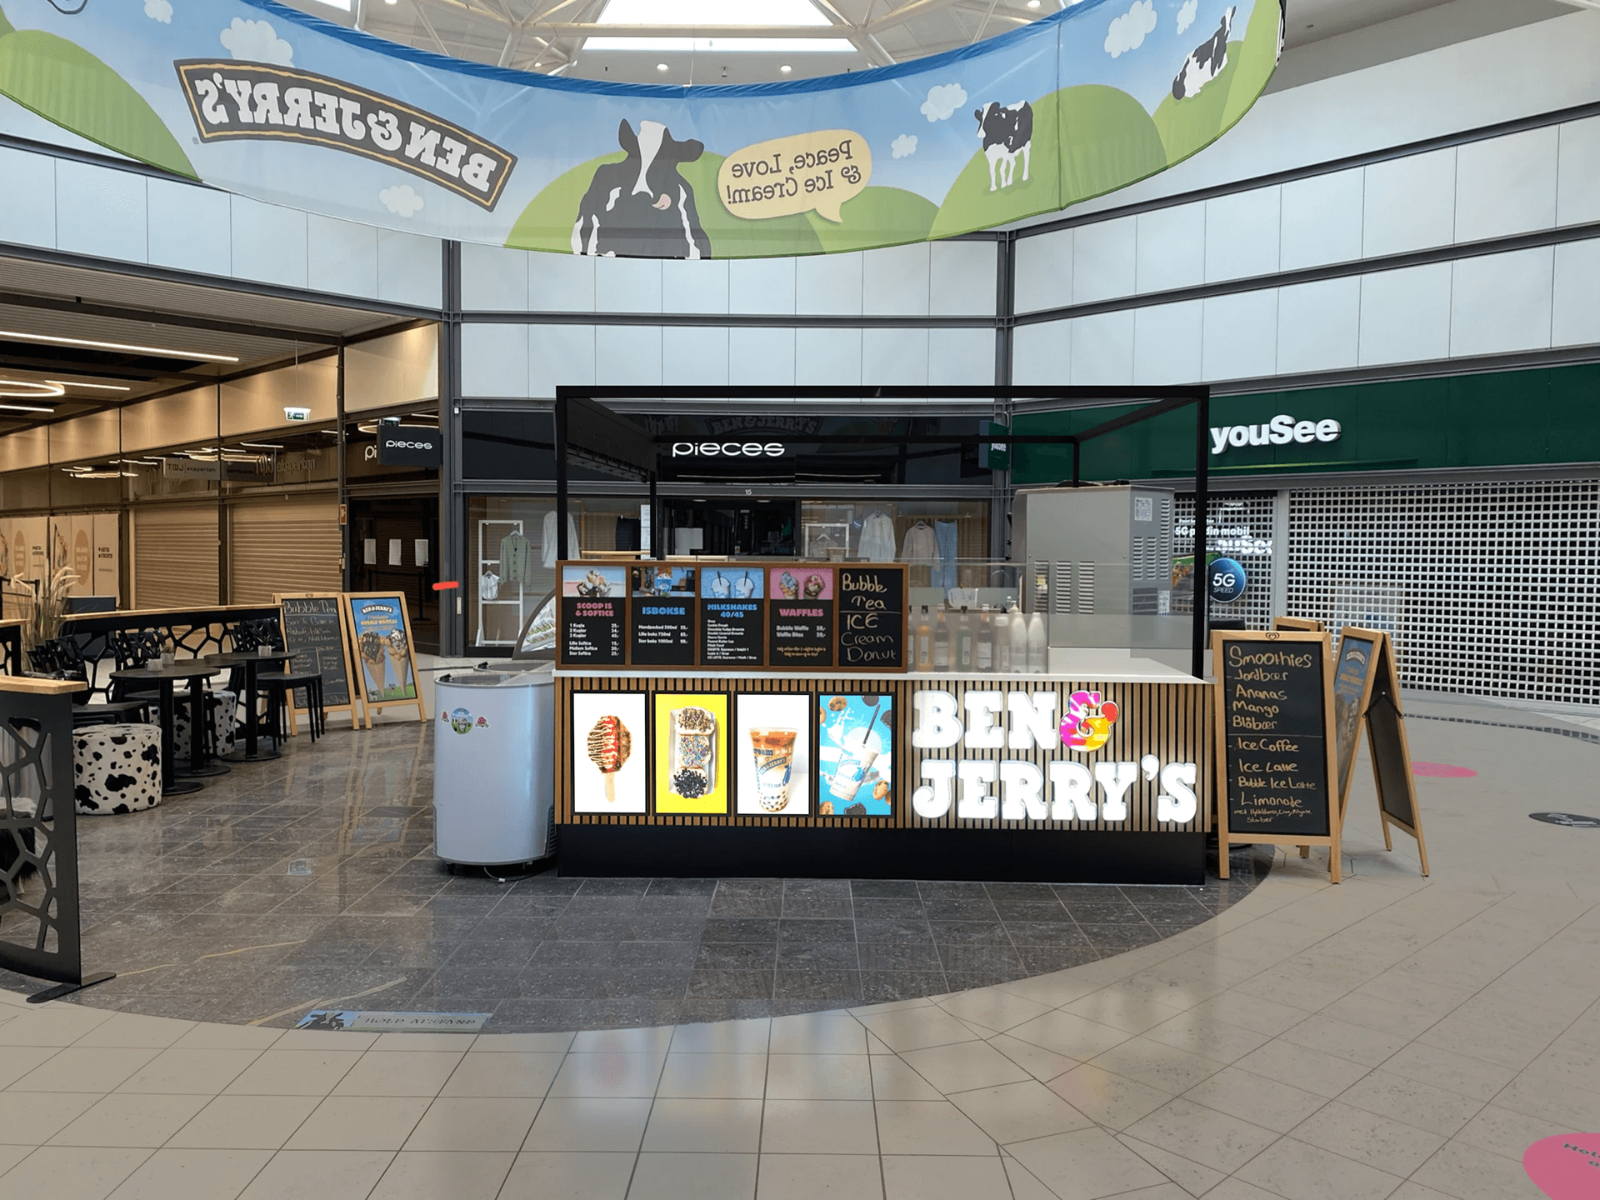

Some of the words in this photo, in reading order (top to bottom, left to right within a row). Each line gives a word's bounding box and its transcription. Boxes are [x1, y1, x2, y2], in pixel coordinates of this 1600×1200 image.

[1210, 414, 1342, 455] youSee
[385, 439, 433, 450] pieces
[672, 441, 785, 457] pieces
[1175, 526, 1189, 536] 5G
[1220, 525, 1250, 536] mobil
[842, 572, 888, 593] Bubble
[1212, 572, 1236, 587] 5G
[1213, 586, 1234, 594] SPEED
[283, 600, 319, 614] Bubble
[576, 602, 604, 610] SCOOP
[604, 602, 613, 610] IS
[642, 606, 686, 616] ISBOKSE
[707, 603, 758, 611] MILKSHAKES
[851, 595, 887, 611] Tea
[582, 609, 614, 617] SOFTICE
[779, 608, 824, 617] WAFFLES
[846, 612, 880, 631] ICE
[840, 631, 894, 647] Cream
[846, 646, 897, 662] Donut
[1228, 645, 1312, 669] Smoothies
[1235, 683, 1288, 701] Ananas
[1232, 700, 1280, 718] Mango
[912, 690, 1058, 751] BEN
[1059, 690, 1119, 752] &
[1237, 736, 1260, 751] Ice
[1259, 738, 1300, 752] Coffee
[1238, 758, 1264, 773] Ice
[1265, 761, 1299, 773] Latte
[912, 753, 1198, 824] JERRY'S
[1270, 776, 1289, 790] Ice
[1288, 776, 1317, 790] Latte
[1240, 791, 1304, 808] Limonade
